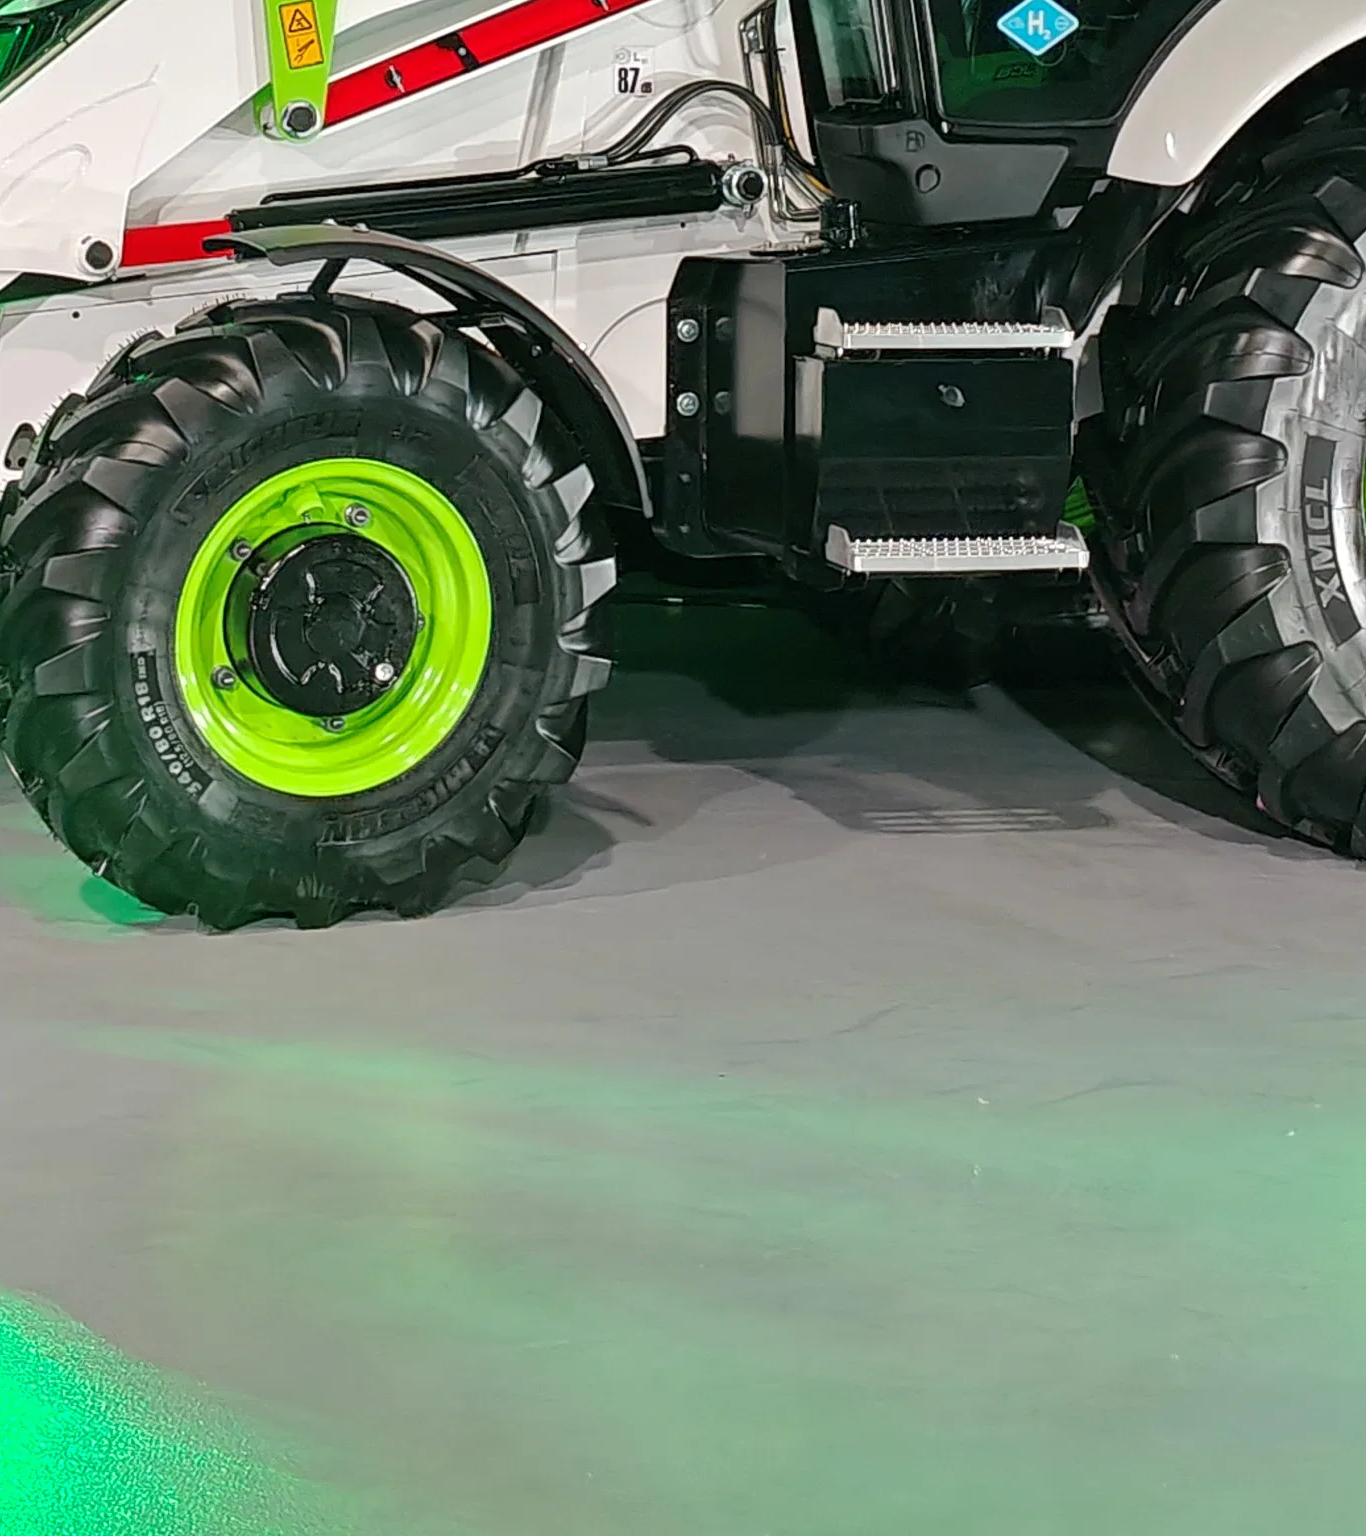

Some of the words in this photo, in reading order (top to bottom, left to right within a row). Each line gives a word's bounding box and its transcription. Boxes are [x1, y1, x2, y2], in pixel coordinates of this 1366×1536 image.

[618, 67, 640, 94] 87
[1305, 477, 1347, 609] XMCL
[135, 681, 156, 723] R18
